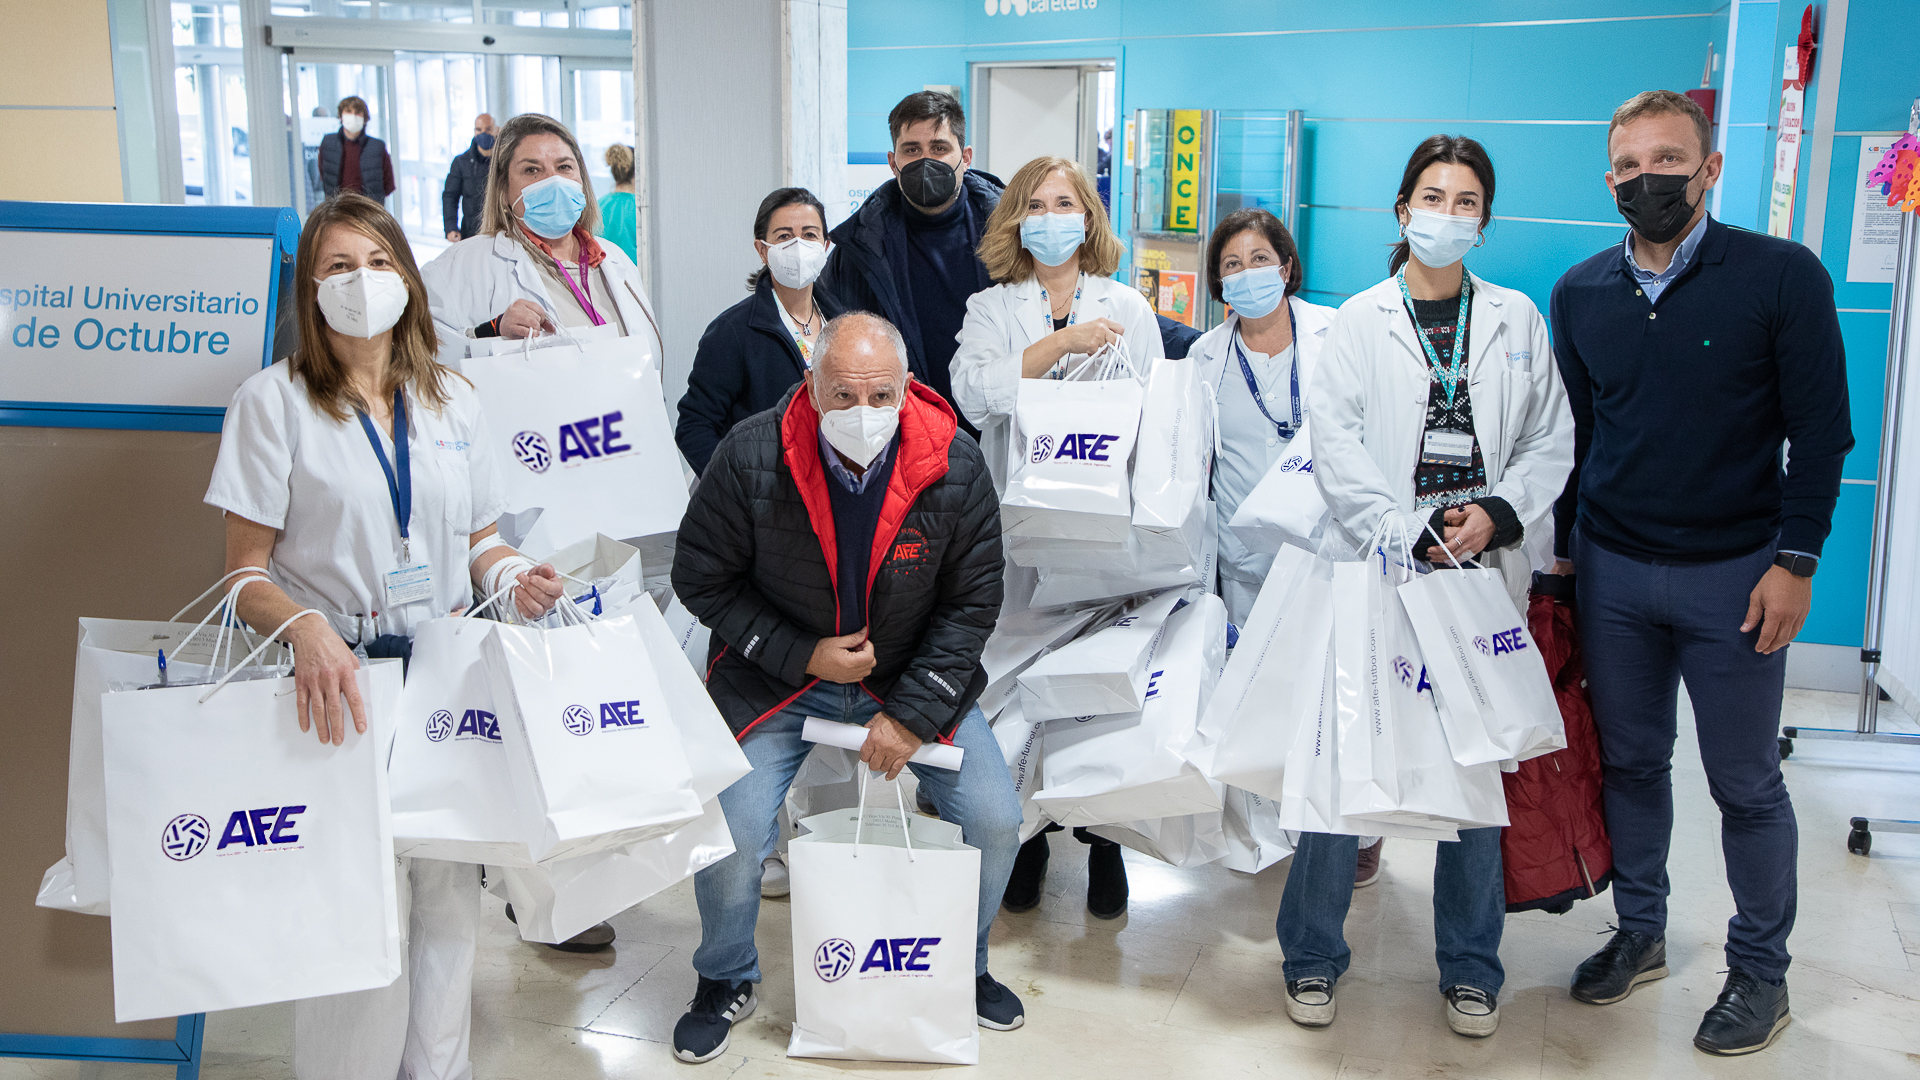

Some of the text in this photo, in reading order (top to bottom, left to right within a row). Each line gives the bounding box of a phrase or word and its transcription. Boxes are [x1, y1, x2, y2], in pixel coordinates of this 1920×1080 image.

[1176, 125, 1195, 225] ONCE
[83, 286, 259, 316] Universitario
[12, 316, 230, 355] de Octubre
[559, 410, 632, 463] AFE
[1054, 433, 1120, 461] AFE
[1171, 407, 1182, 482] www.afe-futbol.com
[893, 543, 922, 560] AFE
[1492, 626, 1527, 656] AFE
[1370, 628, 1382, 737] www.afe-futbol.com
[455, 709, 502, 740] AFE
[599, 700, 644, 729] AFE
[216, 805, 307, 851] AFE
[859, 937, 942, 973] AFE
